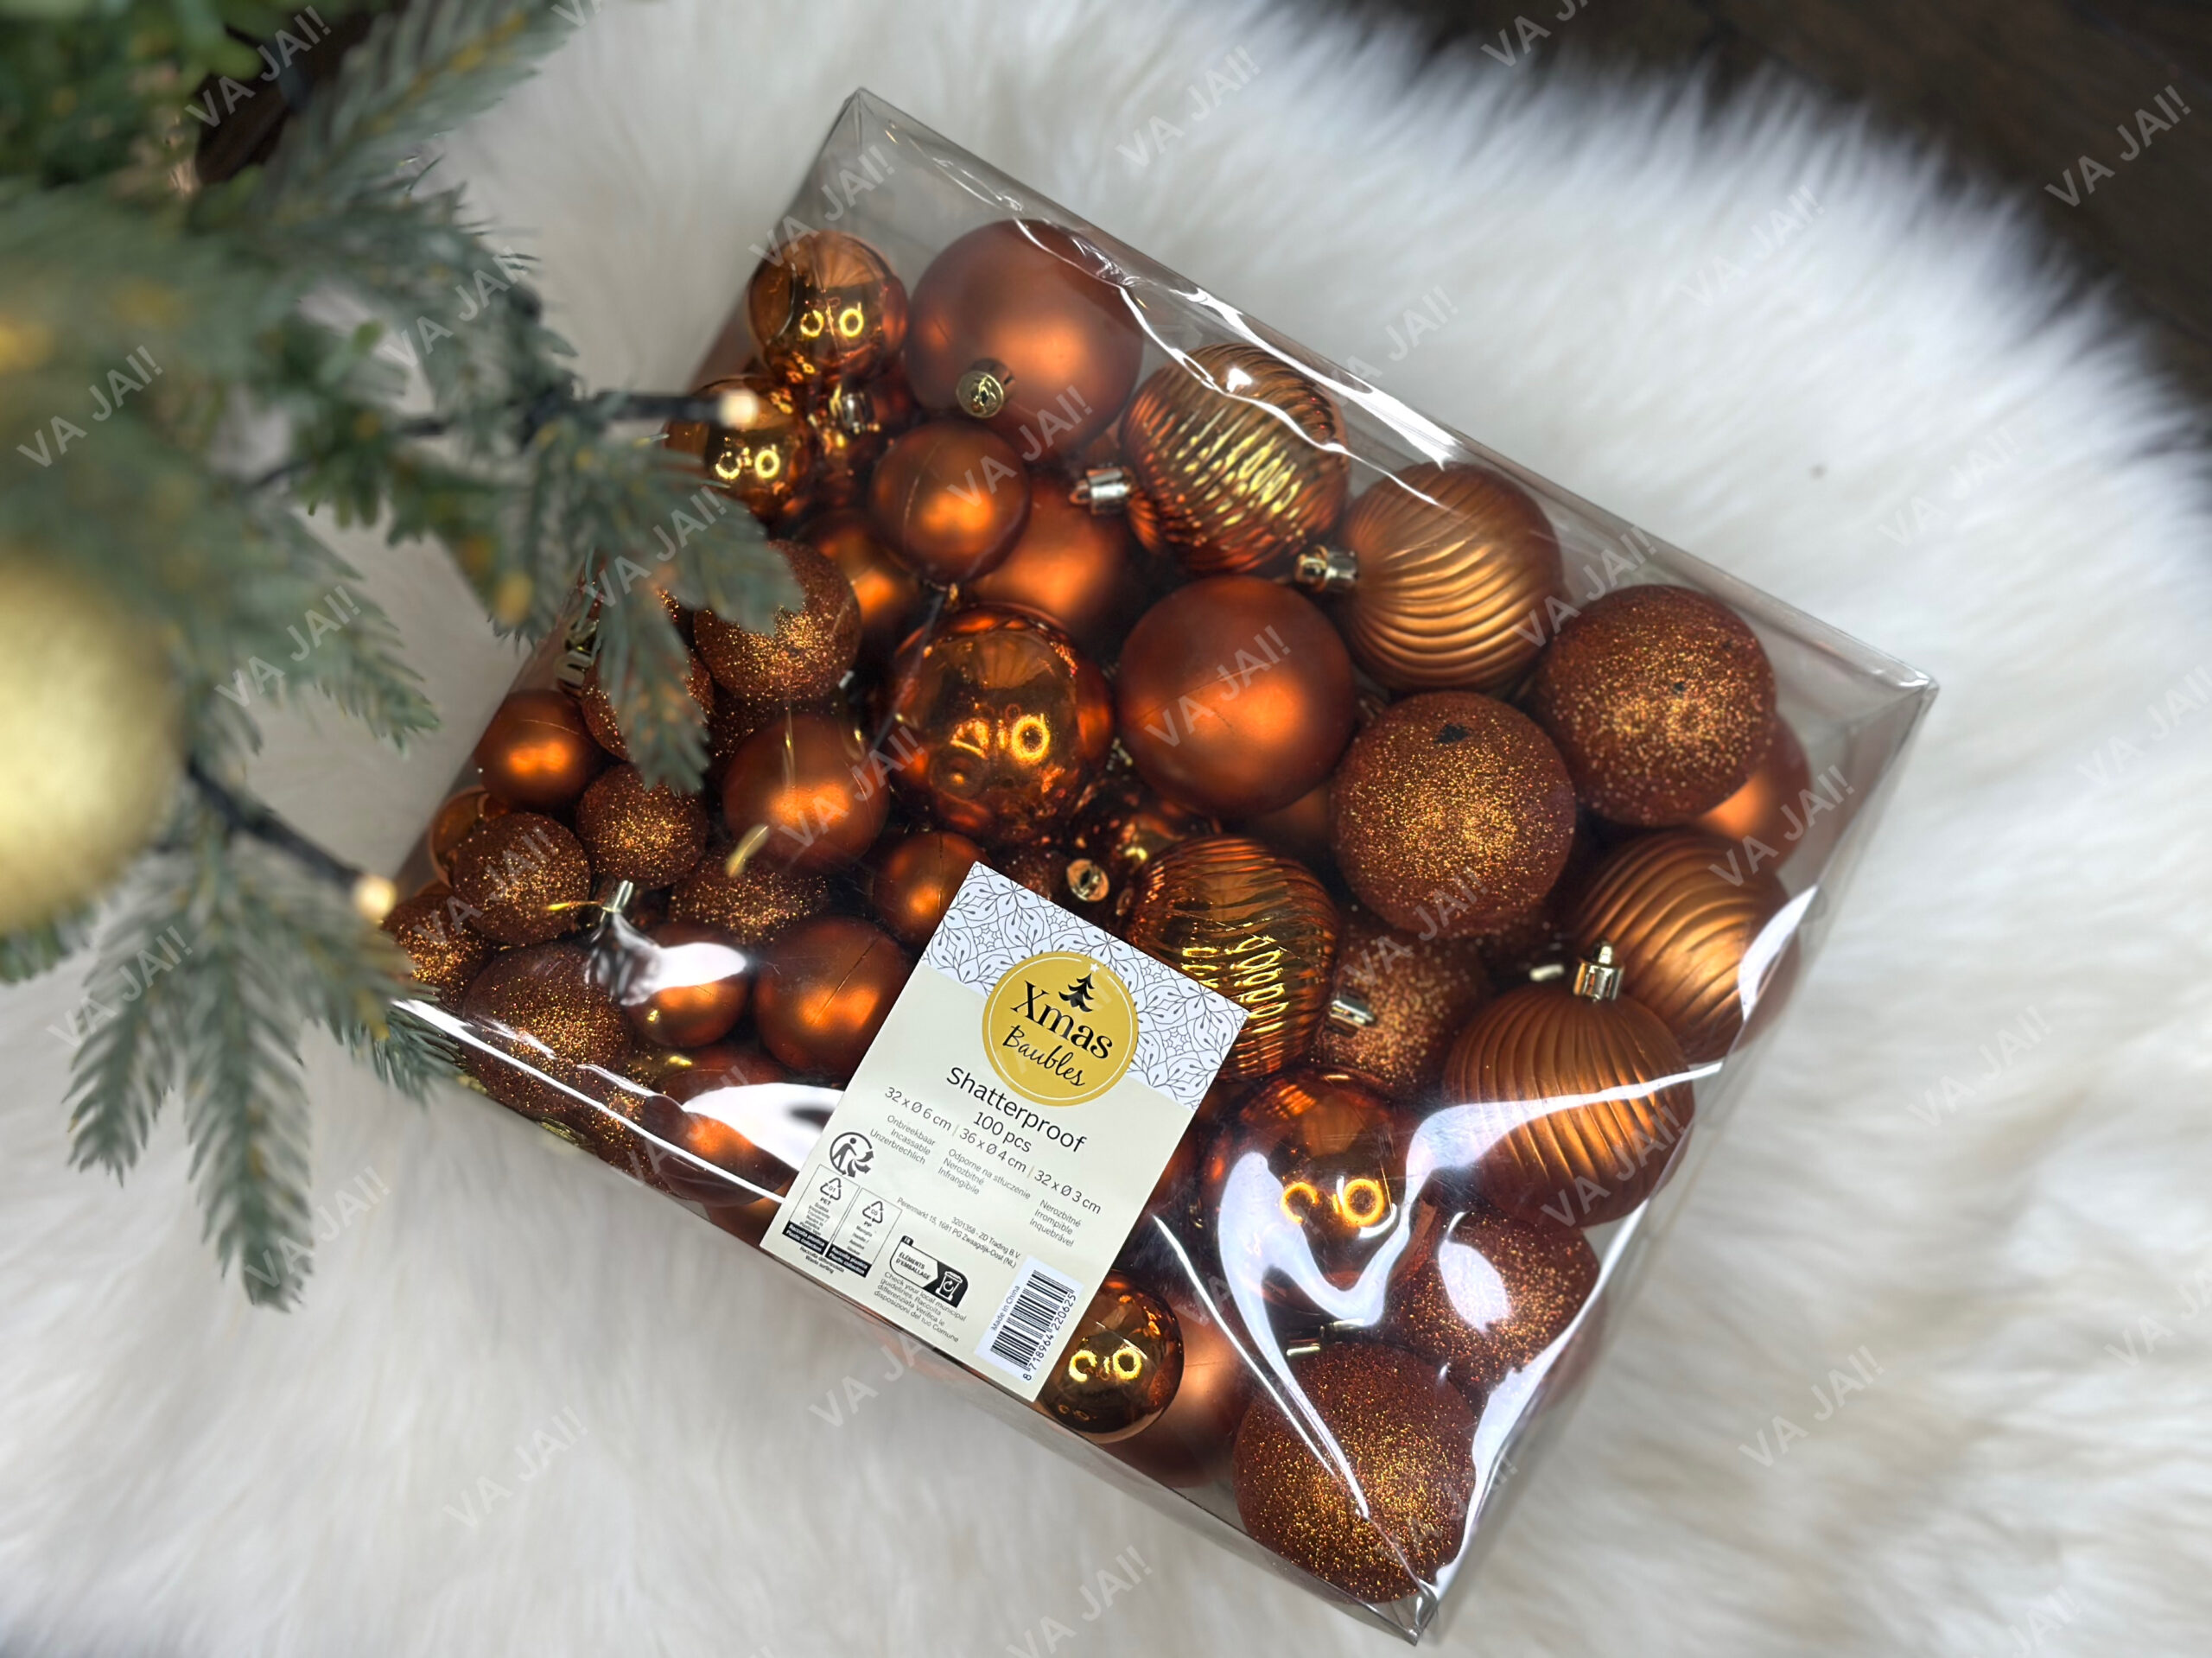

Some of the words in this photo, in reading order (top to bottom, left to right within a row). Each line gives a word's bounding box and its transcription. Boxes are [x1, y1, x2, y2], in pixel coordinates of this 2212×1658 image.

[1010, 980, 1113, 1059] Xmas
[1001, 1025, 1086, 1087] Baubles
[946, 1066, 1088, 1153] Shatterproof
[869, 1128, 926, 1166] Unzerbrechlich
[887, 1115, 936, 1147] Onbreekbaar
[890, 1128, 931, 1156] Incassable
[973, 1111, 1004, 1136] 100
[1001, 1131, 1032, 1153] pcs
[885, 1086, 903, 1103] 32
[901, 1097, 911, 1109] x
[923, 1108, 933, 1120] 6
[932, 1115, 952, 1131] cm
[959, 1128, 977, 1144] 36
[976, 1140, 986, 1150] x
[997, 1150, 1007, 1161] 4
[1007, 1157, 1027, 1173] cm
[1033, 1169, 1052, 1186] 32
[1051, 1181, 1060, 1191] x
[1071, 1191, 1083, 1203] 3
[1082, 1198, 1102, 1215] cm
[938, 1166, 980, 1195] Infrangibile
[943, 1157, 985, 1185] Nerozbitné
[948, 1148, 982, 1172] Odporne
[982, 1168, 993, 1179] na
[993, 1175, 1031, 1200] stłuczenie
[819, 1197, 831, 1206] PET
[1039, 1198, 1082, 1228] Nerozbitné
[785, 1229, 801, 1242] Plastic
[788, 1223, 808, 1238] Raccolta
[806, 1235, 825, 1248] plastica
[951, 1217, 976, 1235] 3201358
[988, 1236, 1009, 1255] Trading
[1029, 1217, 1075, 1248] Inquebrável
[1034, 1208, 1073, 1236] Irrompible
[799, 1246, 818, 1259] Raccolta
[829, 1252, 844, 1263] Plastic
[831, 1247, 851, 1261] Raccolta
[849, 1257, 868, 1270] plastica
[899, 1251, 925, 1270] ÉLÉMENTS
[938, 1220, 953, 1232] 1681
[951, 1227, 963, 1238] PG
[1002, 1257, 1017, 1269] (NL)
[877, 1284, 915, 1309] differenziata
[915, 1305, 938, 1323] Verifica
[884, 1271, 905, 1286] Check
[904, 1284, 920, 1294] your
[918, 1291, 937, 1305] local
[934, 1301, 968, 1322] municipal
[913, 1296, 942, 1316] Raccolta
[990, 1312, 1006, 1331] Made
[1006, 1285, 1020, 1305] China
[874, 1290, 911, 1314] disposizioni
[910, 1311, 922, 1320] del
[920, 1317, 932, 1327] tuo
[932, 1324, 959, 1344] Comune
[1022, 1373, 1033, 1382] 8
[1028, 1334, 1054, 1371] 718964
[1051, 1291, 1077, 1331] 220625
